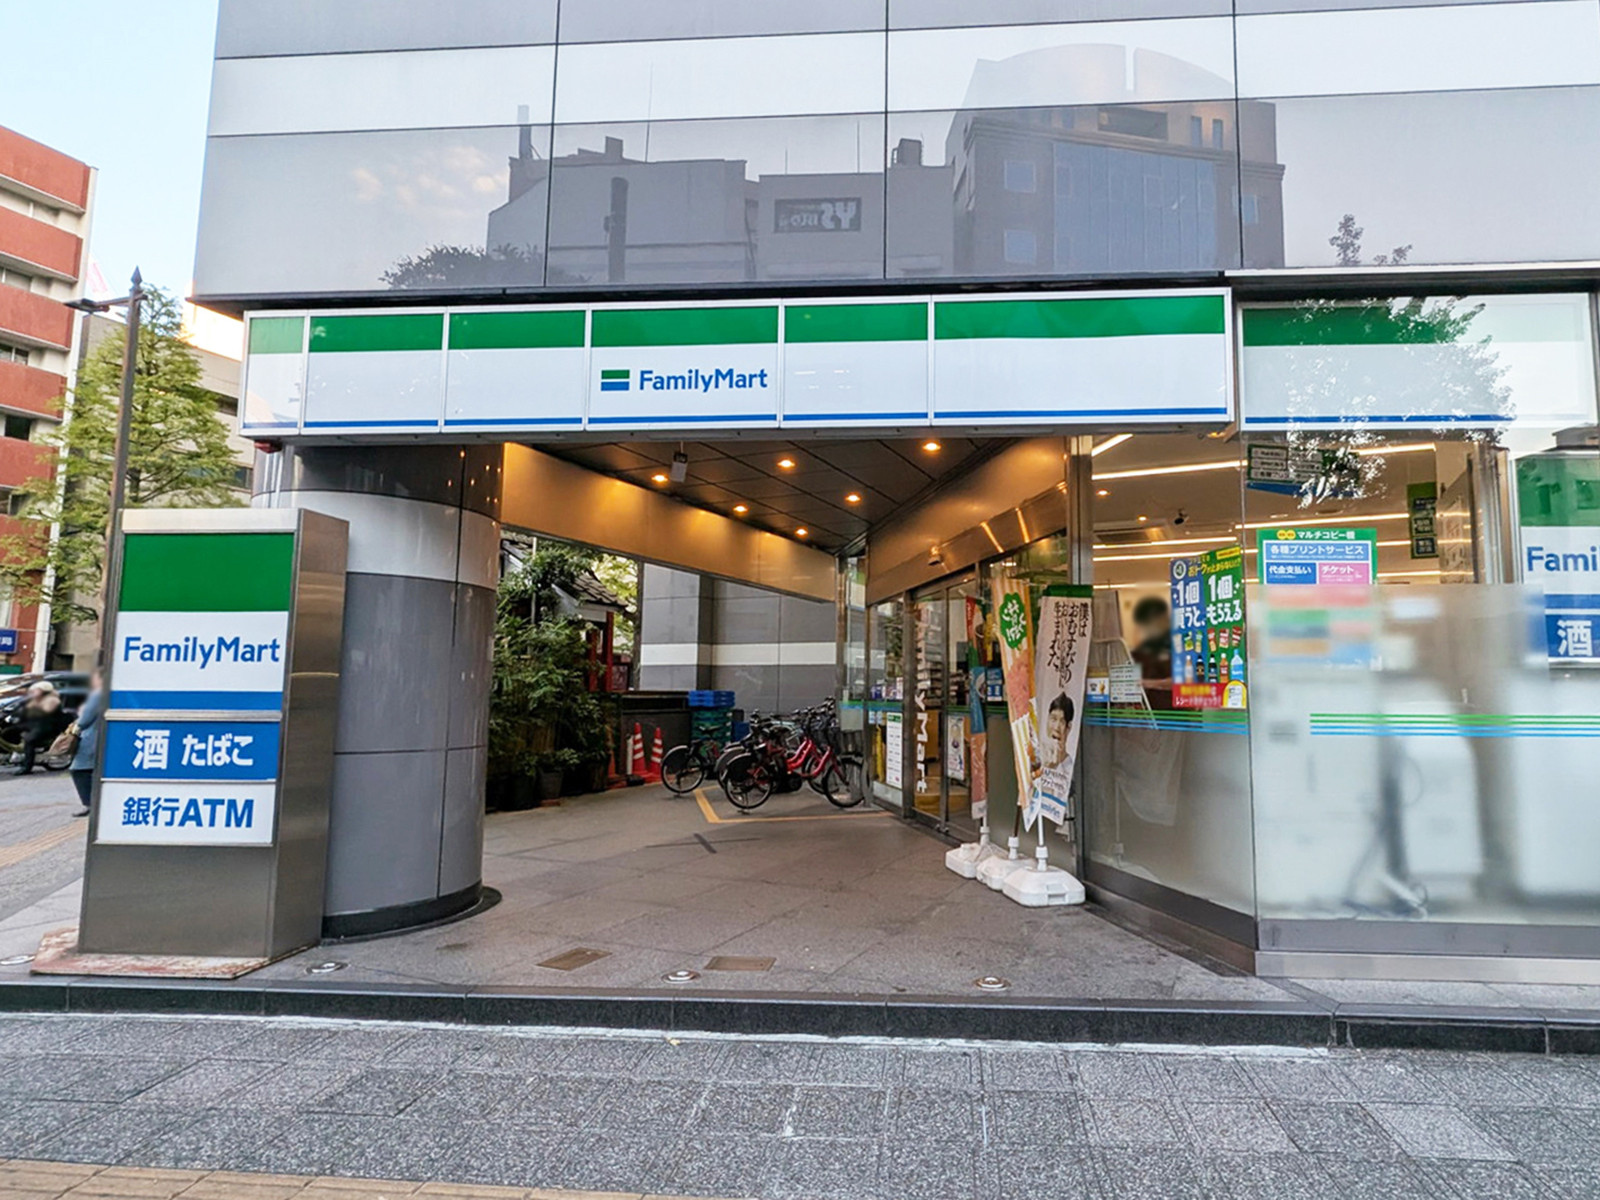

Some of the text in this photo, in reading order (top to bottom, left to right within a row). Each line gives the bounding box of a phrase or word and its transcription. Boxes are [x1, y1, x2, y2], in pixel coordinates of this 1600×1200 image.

[639, 368, 768, 393] FamilyMart
[1297, 531, 1356, 540] マルチコピー機
[1271, 545, 1364, 555] 各種プリントサービス
[1527, 545, 1600, 572] Fami
[1268, 565, 1312, 575] 代金支払い
[1321, 565, 1354, 575] チケット
[1208, 574, 1233, 602] 1個
[1206, 599, 1242, 625] もらえる
[1556, 619, 1593, 657] 酒
[123, 636, 281, 669] FamilyMart
[132, 728, 254, 770] 酒 たばこ
[122, 796, 255, 828] 銀行ATM
